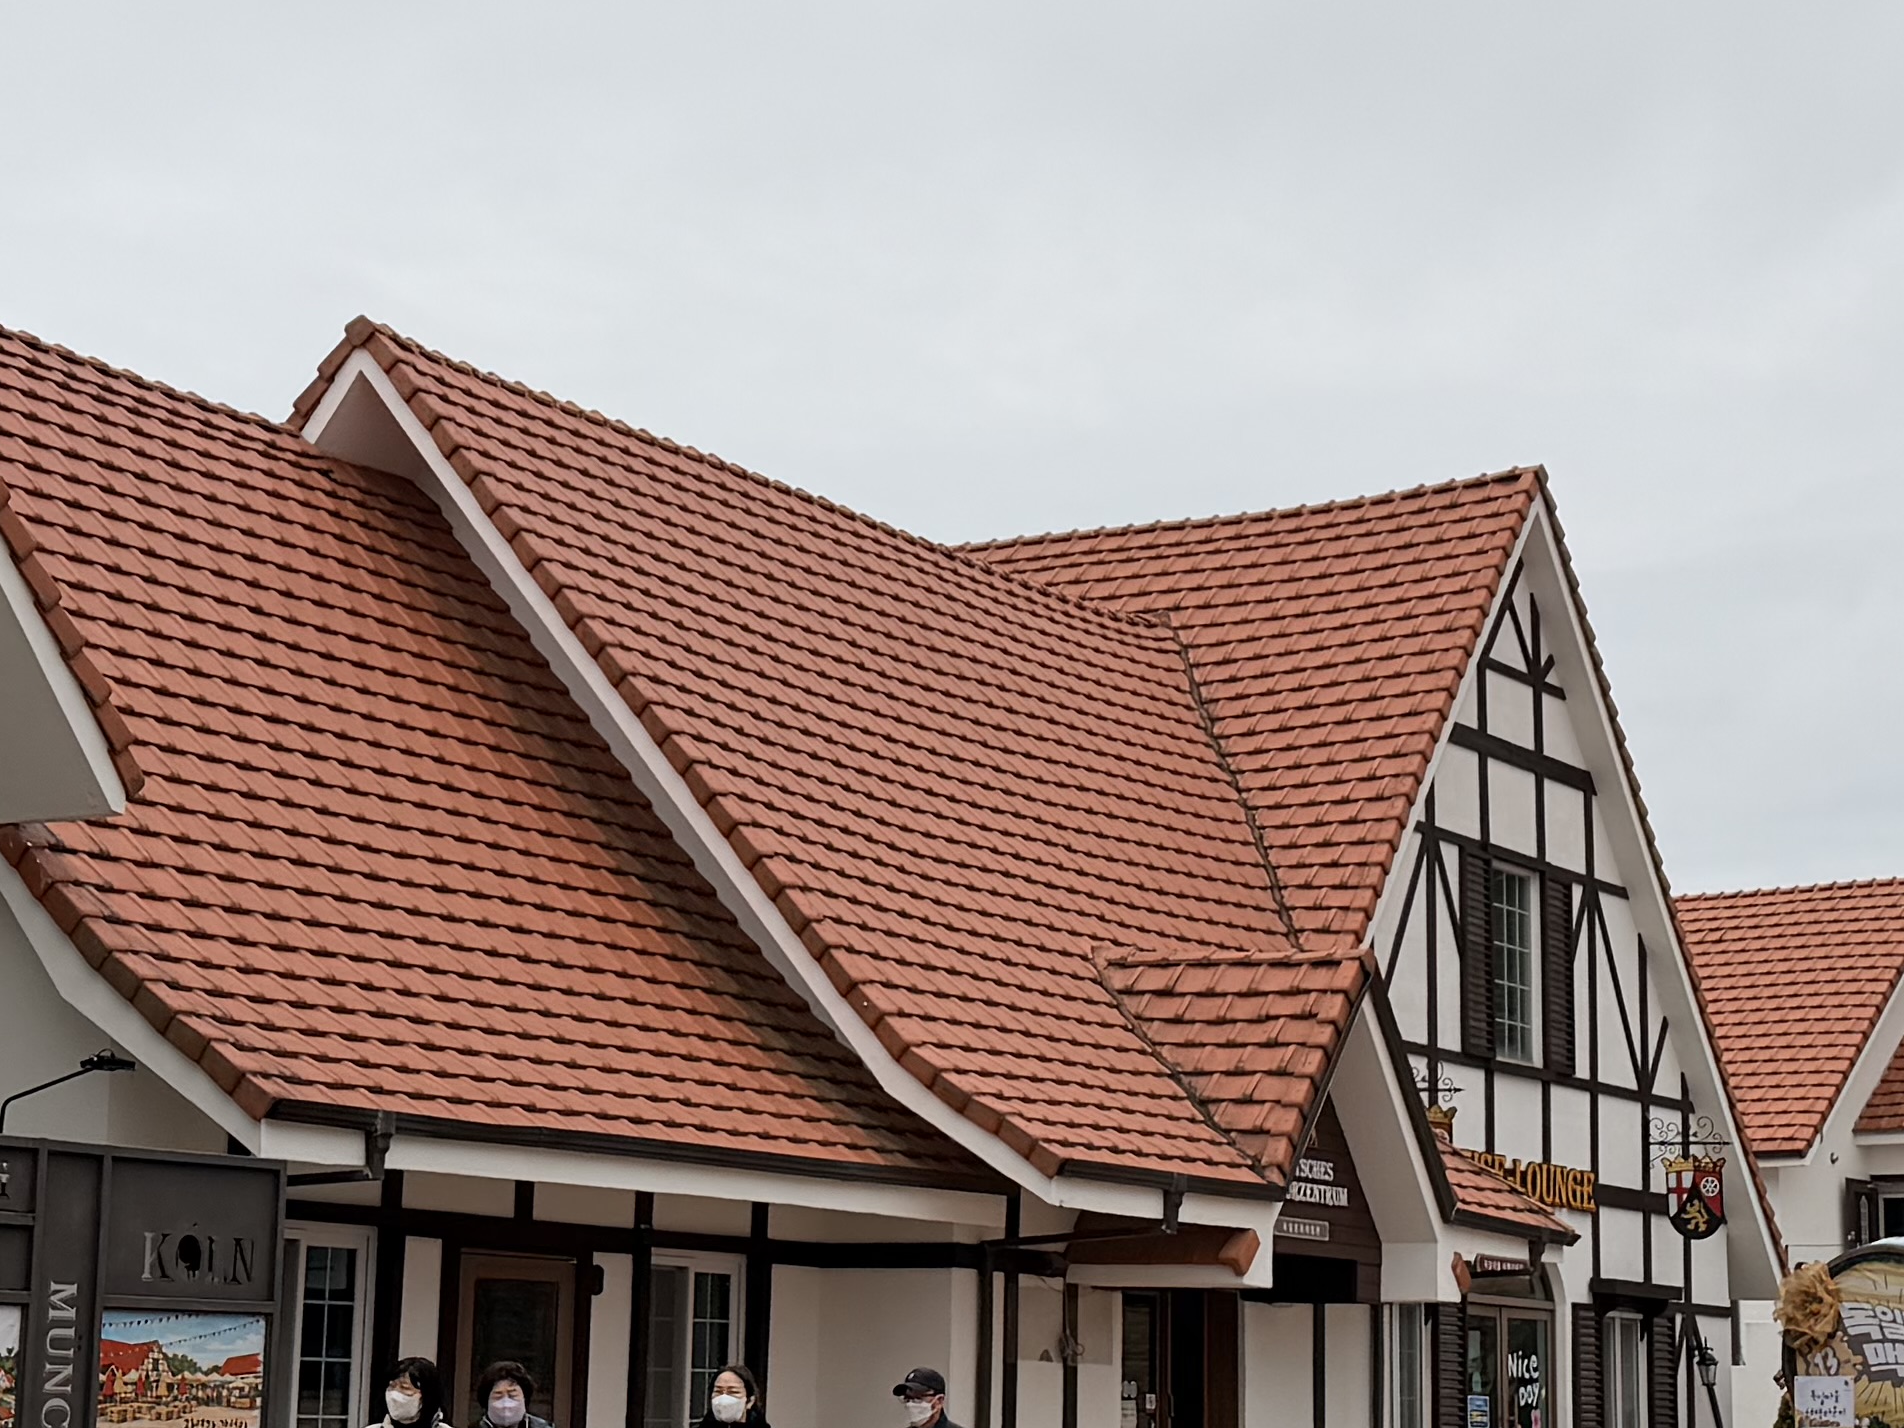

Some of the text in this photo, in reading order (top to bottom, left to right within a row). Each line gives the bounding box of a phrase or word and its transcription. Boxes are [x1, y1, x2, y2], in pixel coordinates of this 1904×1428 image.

[1286, 1181, 1349, 1206] RZENTRUM
[1458, 1150, 1596, 1212] SE-LOUNGE
[1507, 1350, 1539, 1379] Nice
